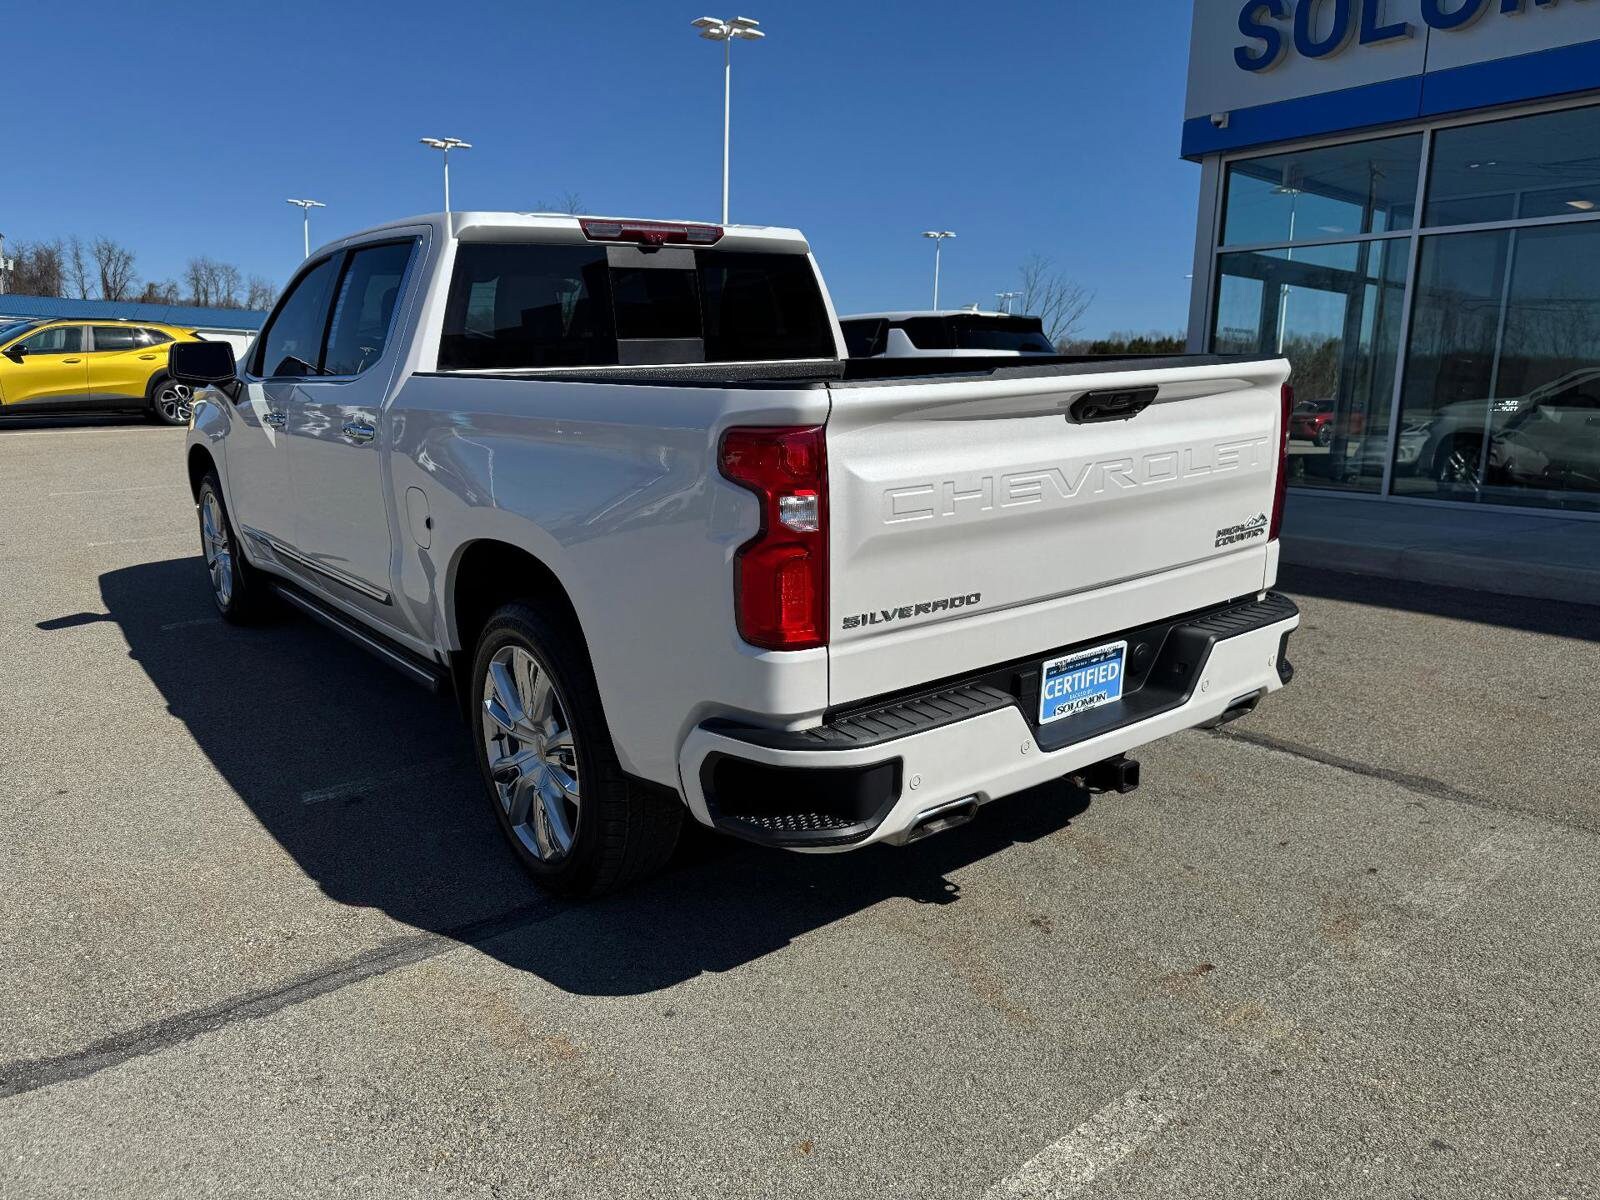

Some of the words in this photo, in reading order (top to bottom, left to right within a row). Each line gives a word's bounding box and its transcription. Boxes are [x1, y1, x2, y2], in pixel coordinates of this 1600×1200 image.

[1234, 0, 1566, 71] SOL
[884, 437, 1268, 524] CHEVROLET
[1215, 528, 1264, 548] COUNTRY
[1216, 524, 1245, 538] HIGH
[842, 593, 981, 629] SILVERADO
[1045, 663, 1119, 699] CERTIFIED
[1056, 693, 1106, 715] SOLOMON
